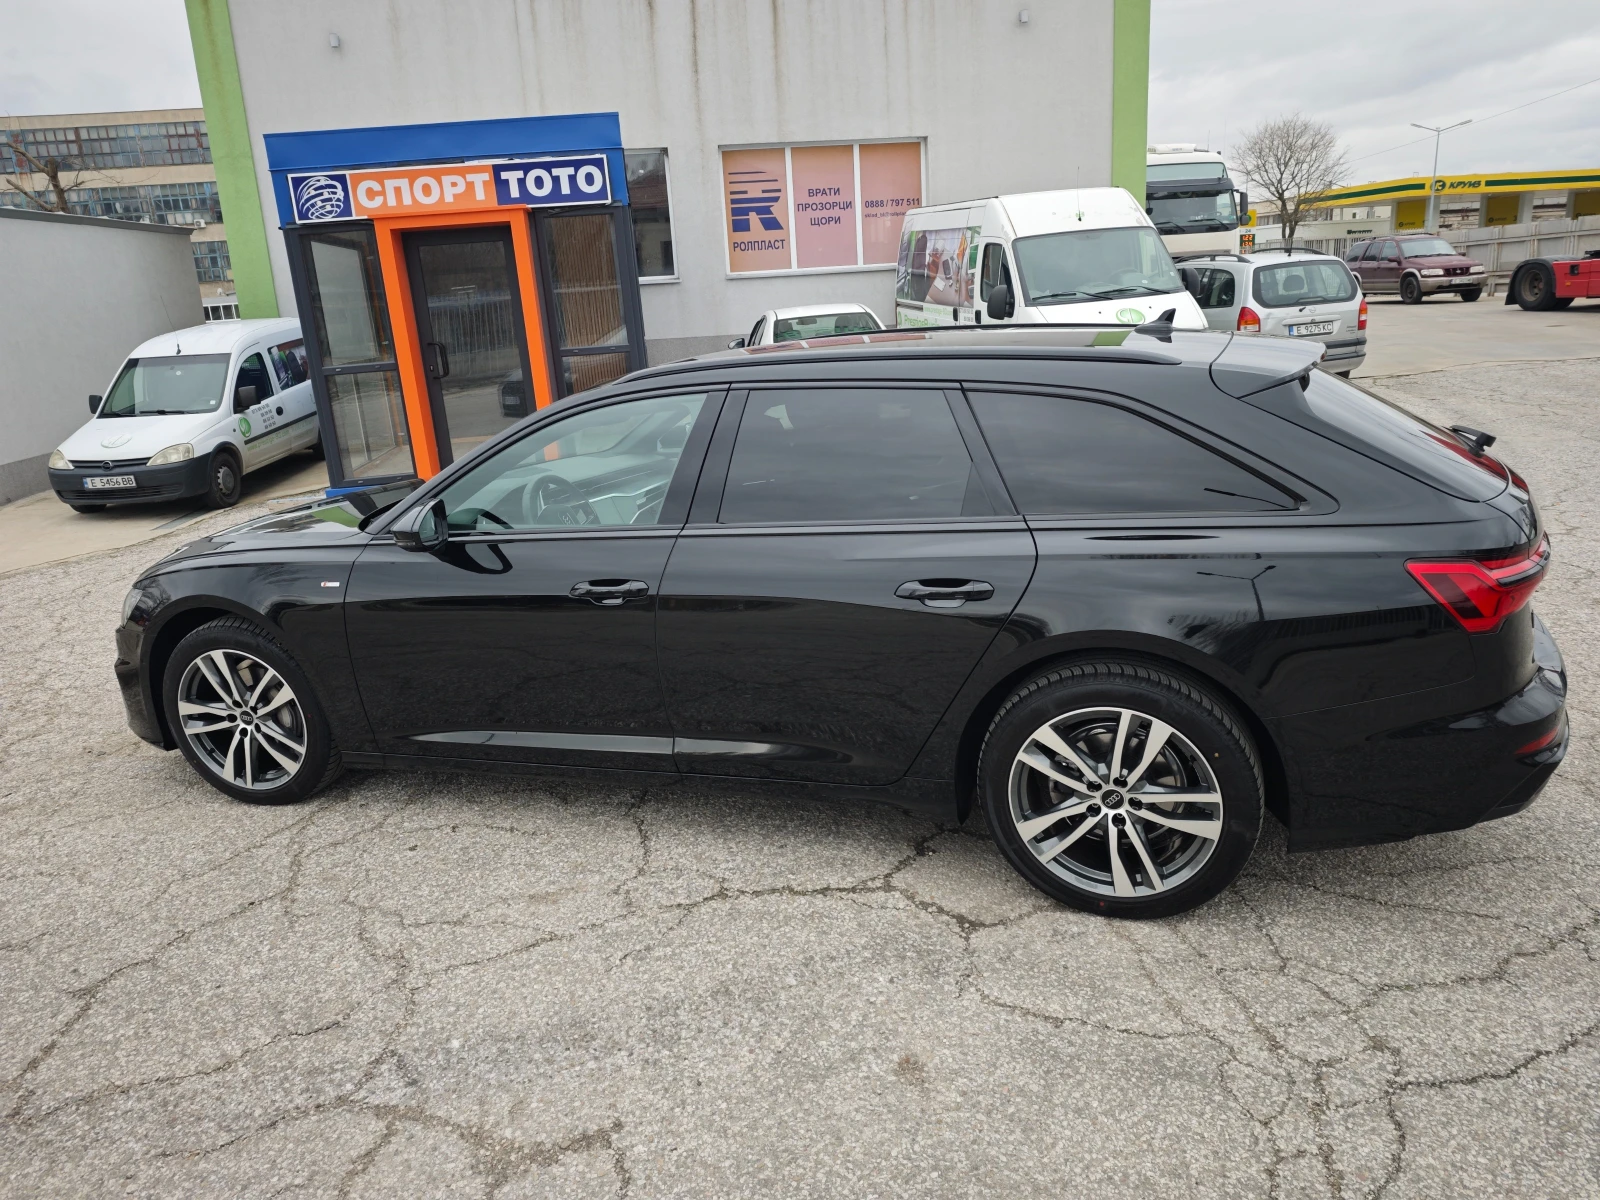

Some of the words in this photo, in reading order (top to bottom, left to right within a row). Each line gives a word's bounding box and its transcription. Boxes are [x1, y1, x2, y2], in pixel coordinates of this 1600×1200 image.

[356, 172, 491, 209] СПОРТ
[500, 164, 604, 199] ТОТО
[808, 187, 841, 198] ВРАТИ
[797, 201, 853, 213] ПРОЗОРЦИ
[864, 199, 885, 208] 0888
[890, 198, 905, 207] 797
[906, 196, 920, 206] 511
[810, 216, 841, 227] ЩОРИ
[733, 239, 786, 252] РОЛПЛАСТ
[1297, 326, 1302, 335] E
[1304, 324, 1322, 334] 9275
[90, 478, 98, 488] E
[100, 477, 121, 487] 5456
[121, 476, 134, 486] BB
